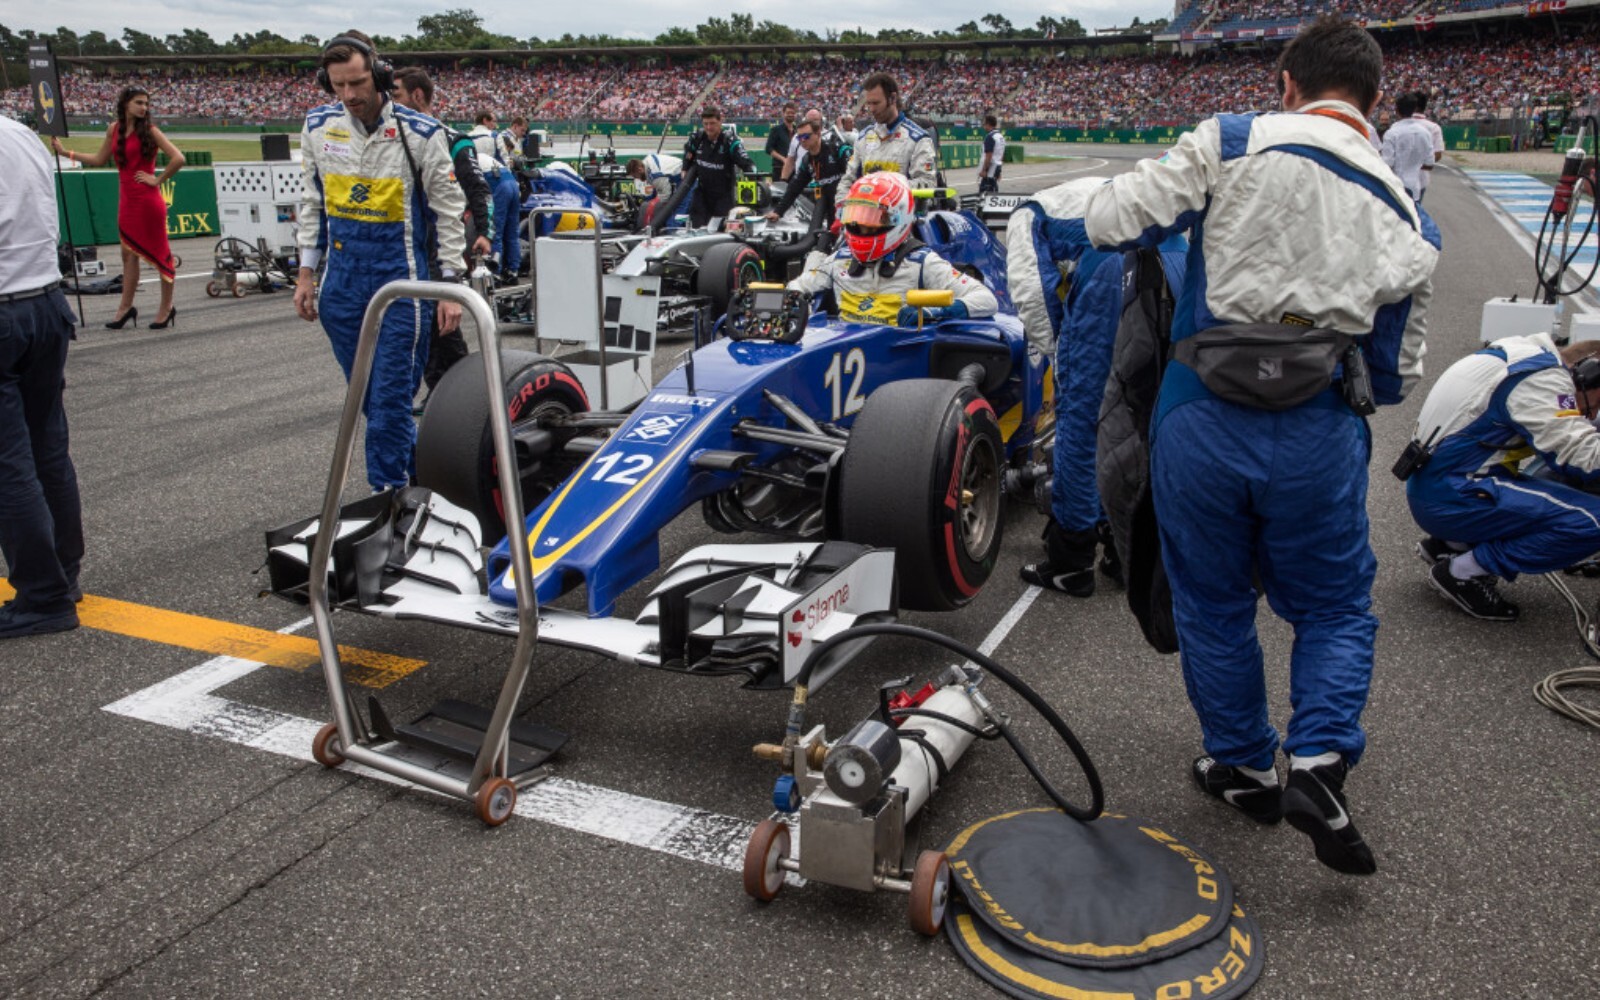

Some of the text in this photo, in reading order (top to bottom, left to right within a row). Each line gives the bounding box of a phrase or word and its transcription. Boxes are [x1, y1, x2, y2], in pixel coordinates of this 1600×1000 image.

[989, 196, 1031, 208] Saub
[166, 212, 213, 234] LEX
[507, 373, 550, 422] ERO
[824, 346, 866, 421] 12
[591, 451, 654, 485] 12
[1155, 926, 1252, 1000] ZERO
